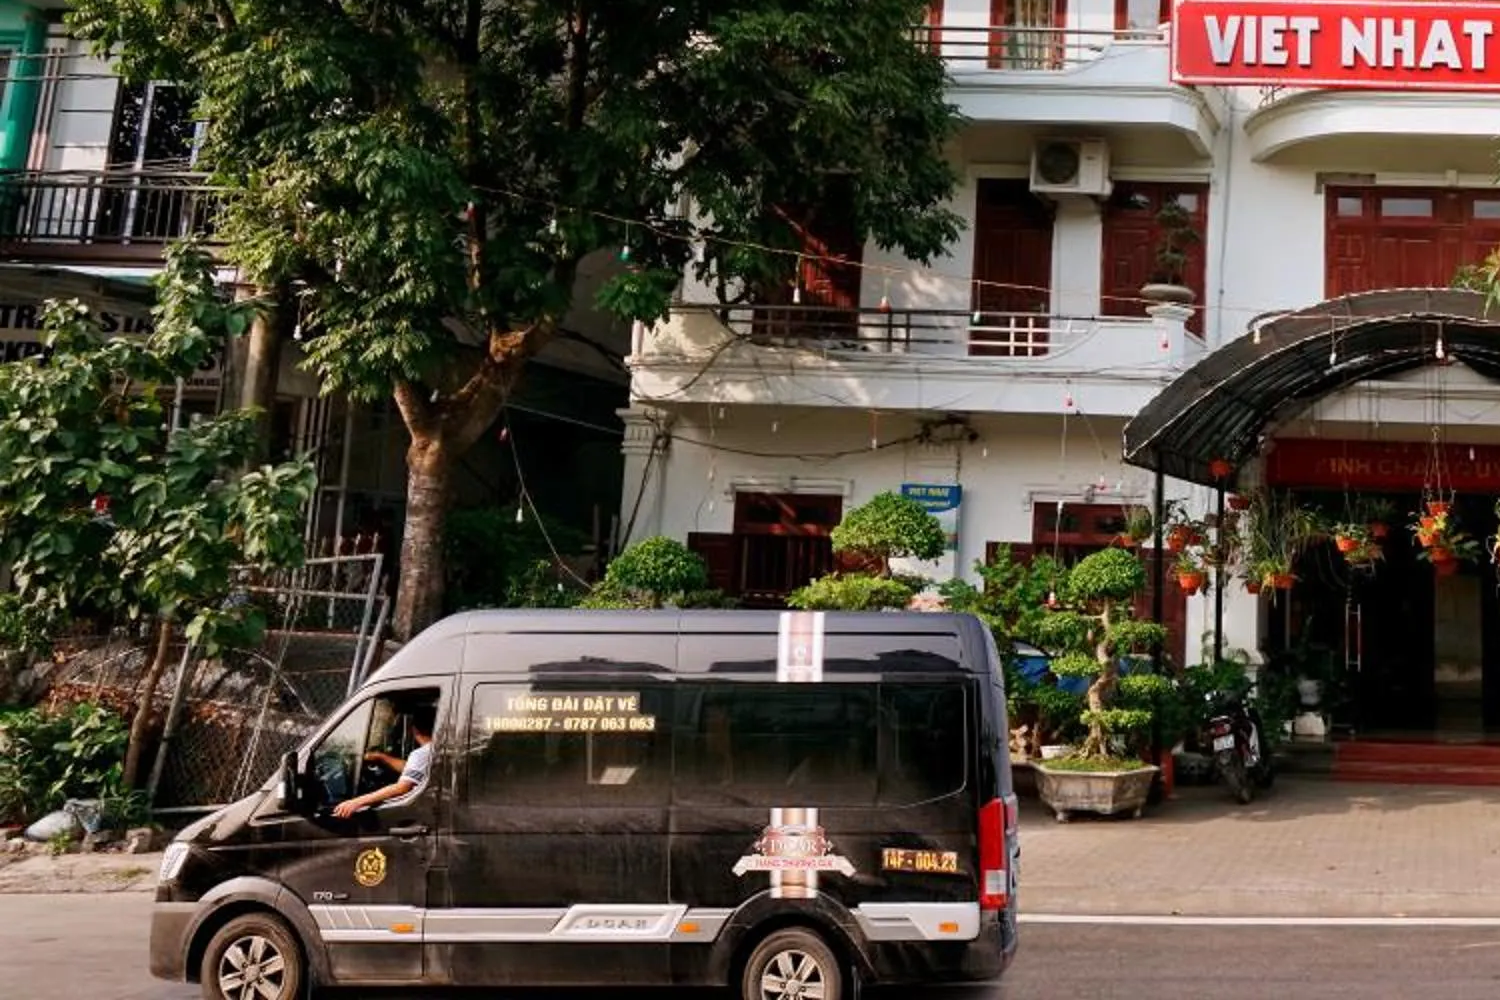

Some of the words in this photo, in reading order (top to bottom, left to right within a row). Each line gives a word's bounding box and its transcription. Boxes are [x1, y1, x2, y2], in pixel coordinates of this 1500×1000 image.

[1204, 15, 1319, 66] VIET
[1341, 17, 1493, 70] NHAT
[601, 717, 626, 730] 063
